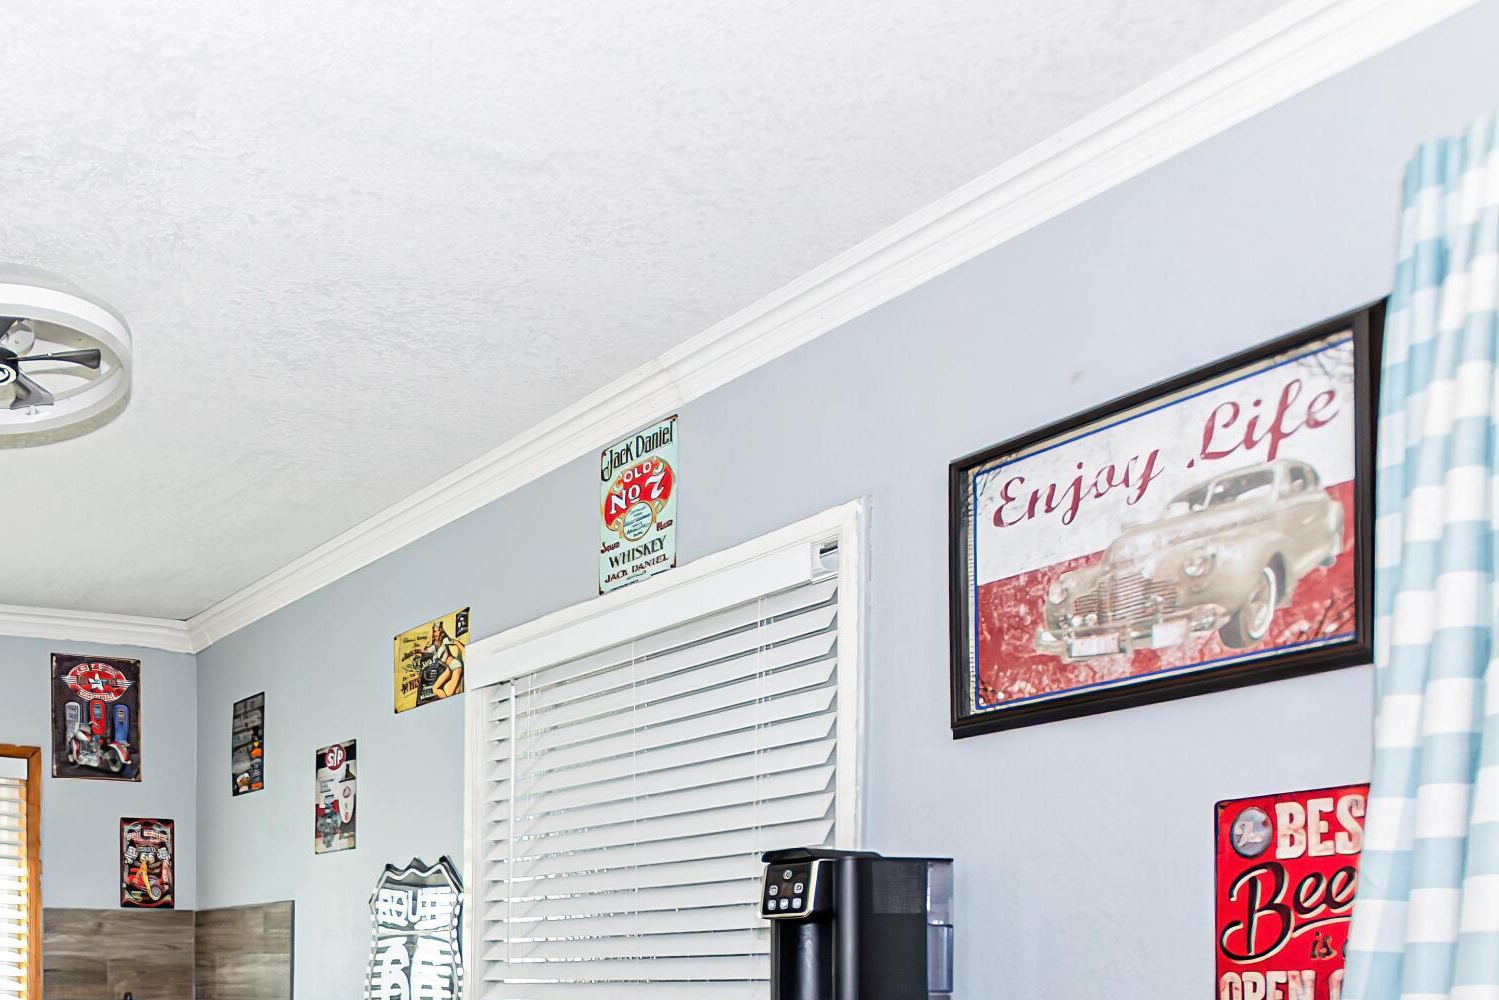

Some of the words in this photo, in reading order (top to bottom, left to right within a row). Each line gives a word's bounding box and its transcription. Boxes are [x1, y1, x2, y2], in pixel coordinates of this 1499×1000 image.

[601, 441, 633, 481] Jack
[636, 421, 674, 458] Daniel
[993, 448, 1165, 528] Enjoy
[1187, 378, 1340, 470] Life
[622, 461, 653, 483] OLD
[645, 471, 666, 500] 7
[609, 535, 667, 568] WHISKEY
[605, 569, 628, 584] JACK
[631, 553, 669, 573] DANIEL
[327, 746, 344, 767] STP
[1309, 931, 1338, 961] is
